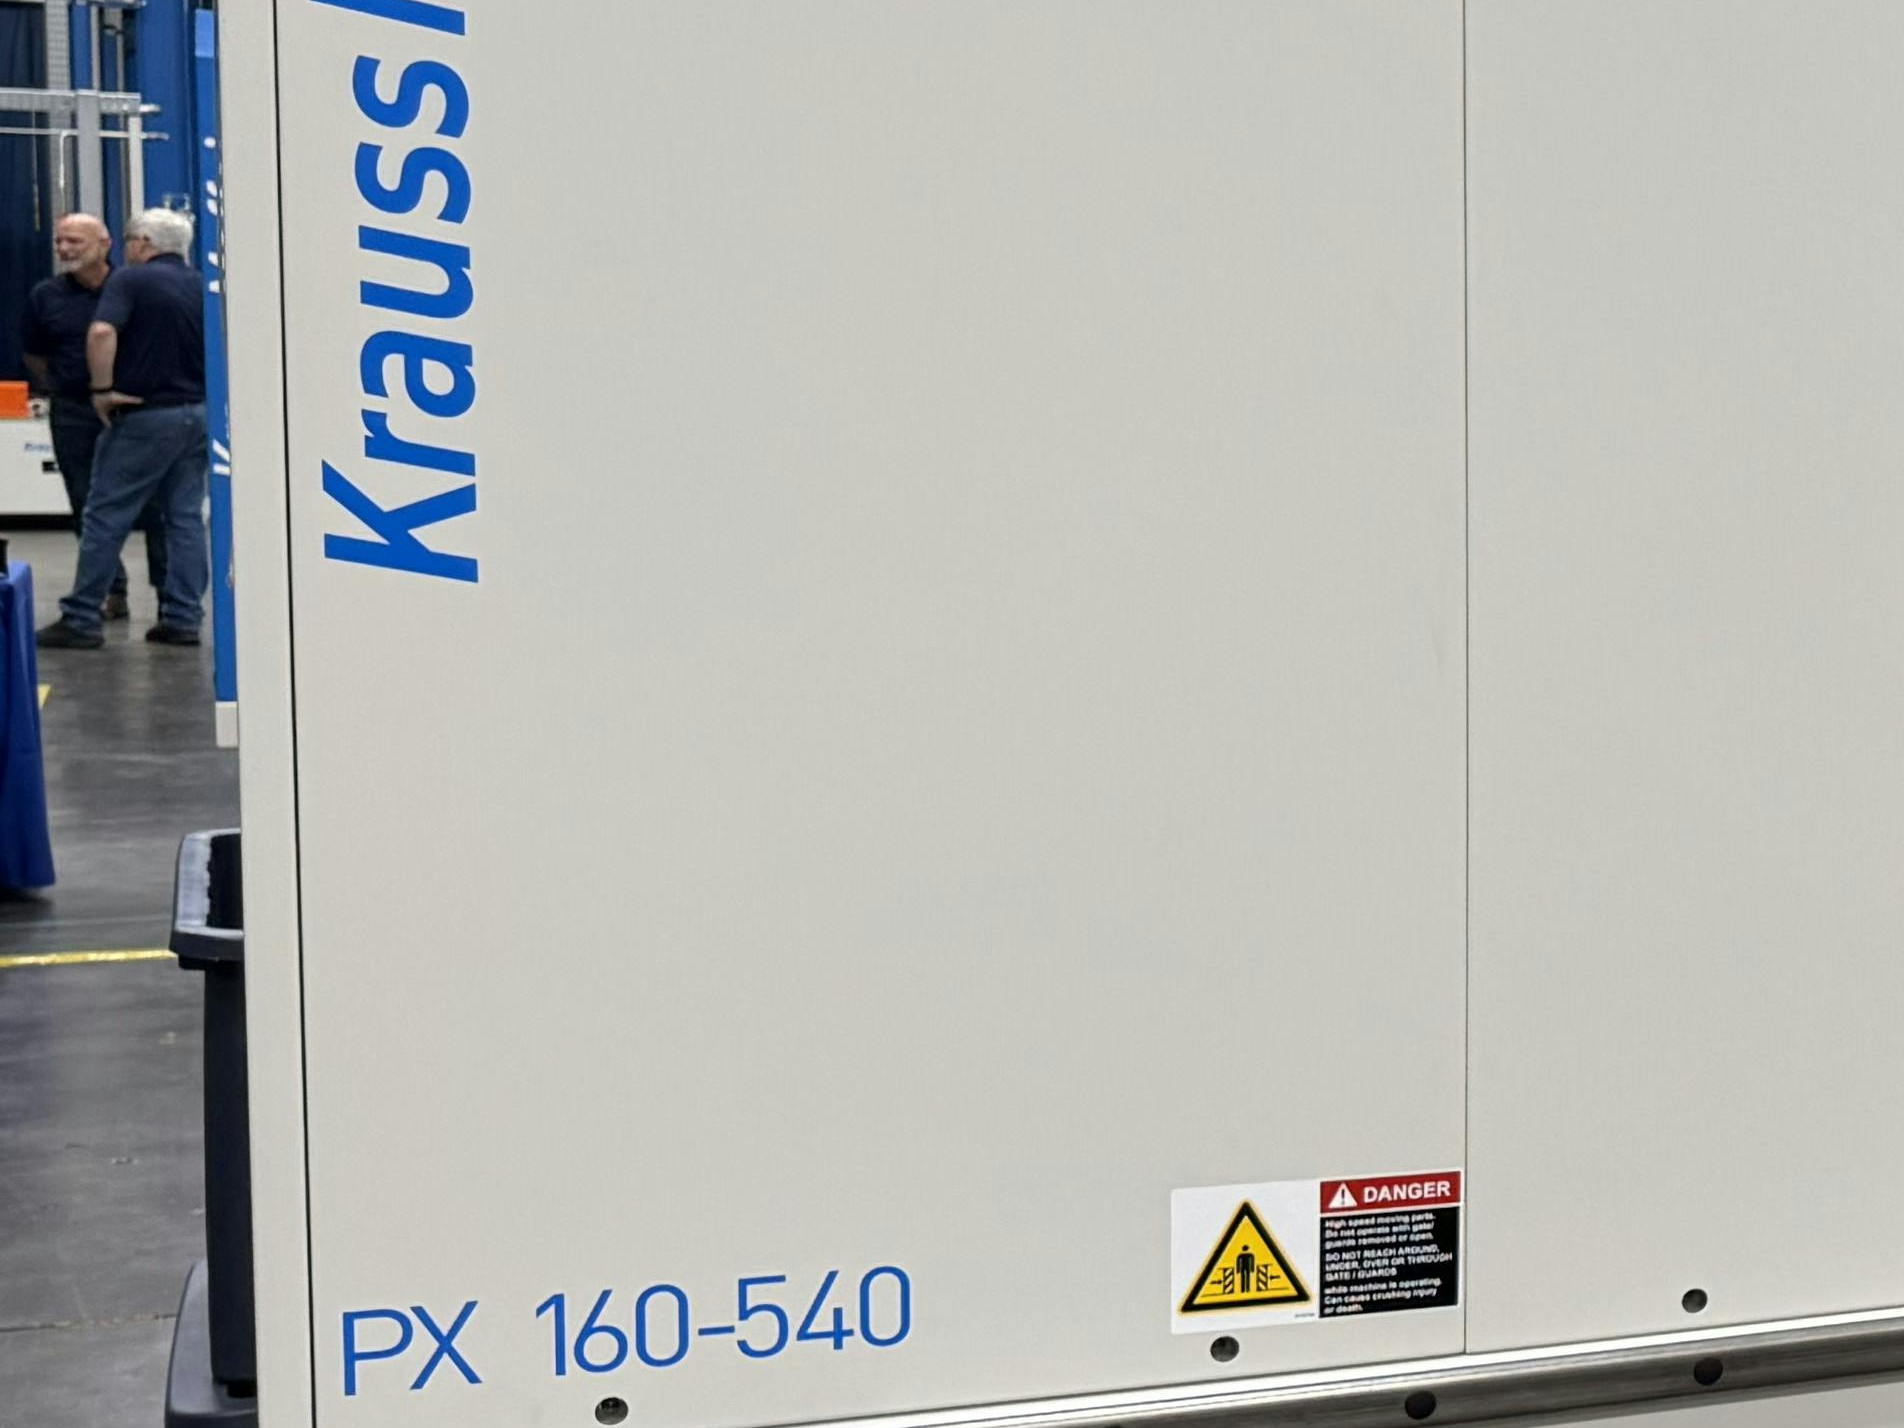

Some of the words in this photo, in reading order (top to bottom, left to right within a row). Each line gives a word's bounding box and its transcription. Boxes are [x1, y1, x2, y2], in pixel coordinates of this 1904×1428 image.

[1363, 1181, 1450, 1203] DANGER
[340, 1301, 482, 1397] PX
[535, 1266, 913, 1377] 160-540
